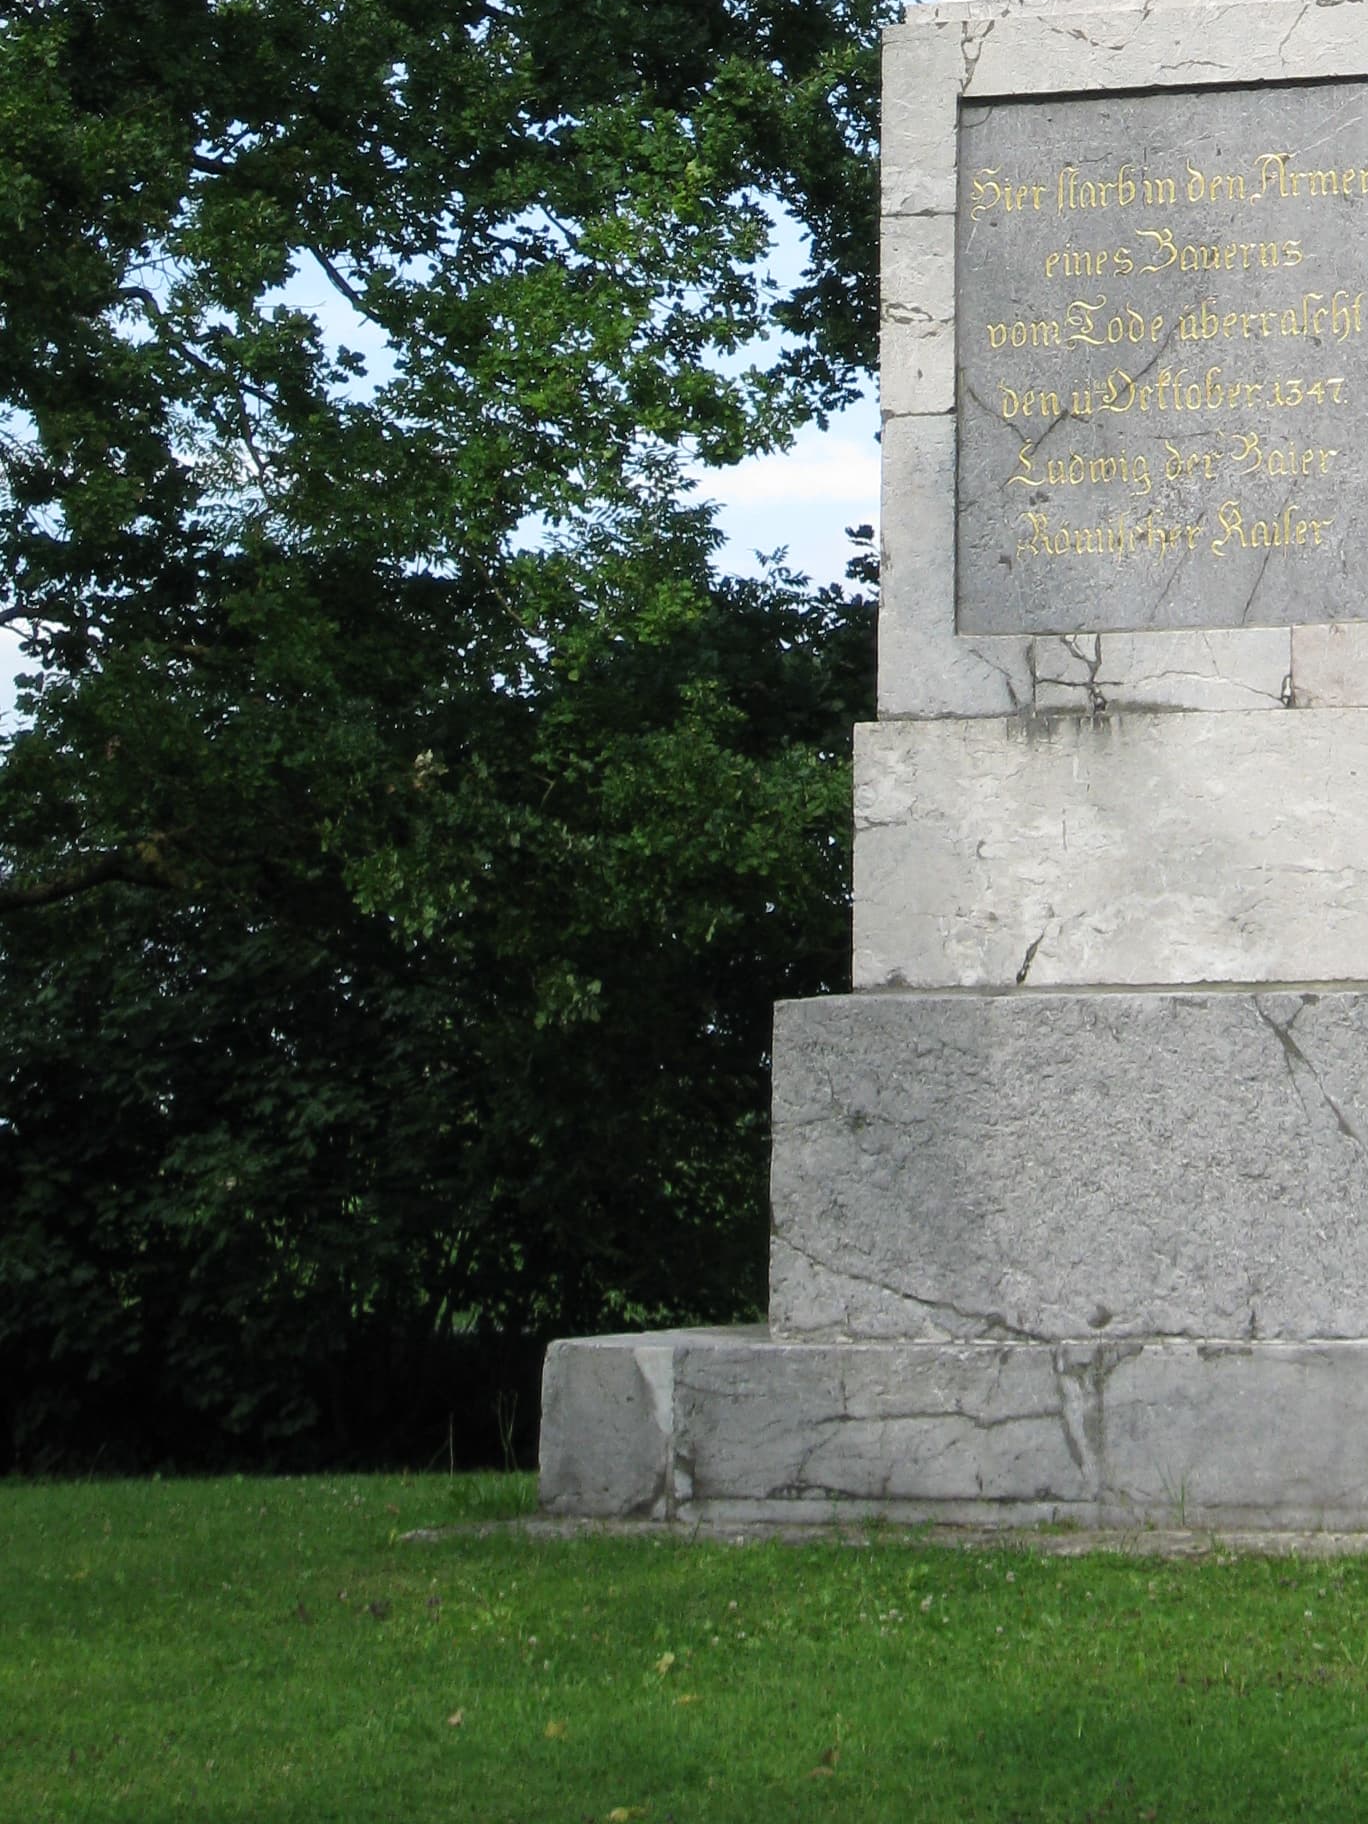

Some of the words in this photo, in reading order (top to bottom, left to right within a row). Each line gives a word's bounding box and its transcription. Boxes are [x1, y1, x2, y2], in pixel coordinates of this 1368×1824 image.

[970, 165, 1047, 222] Hier
[1141, 164, 1177, 207] in
[1187, 157, 1246, 204] den
[1044, 242, 1134, 278] eines
[986, 320, 1062, 349] vom
[1063, 293, 1165, 351] Tode
[997, 378, 1062, 419] den
[1006, 438, 1152, 497] Ludwig
[1164, 437, 1222, 480] der
